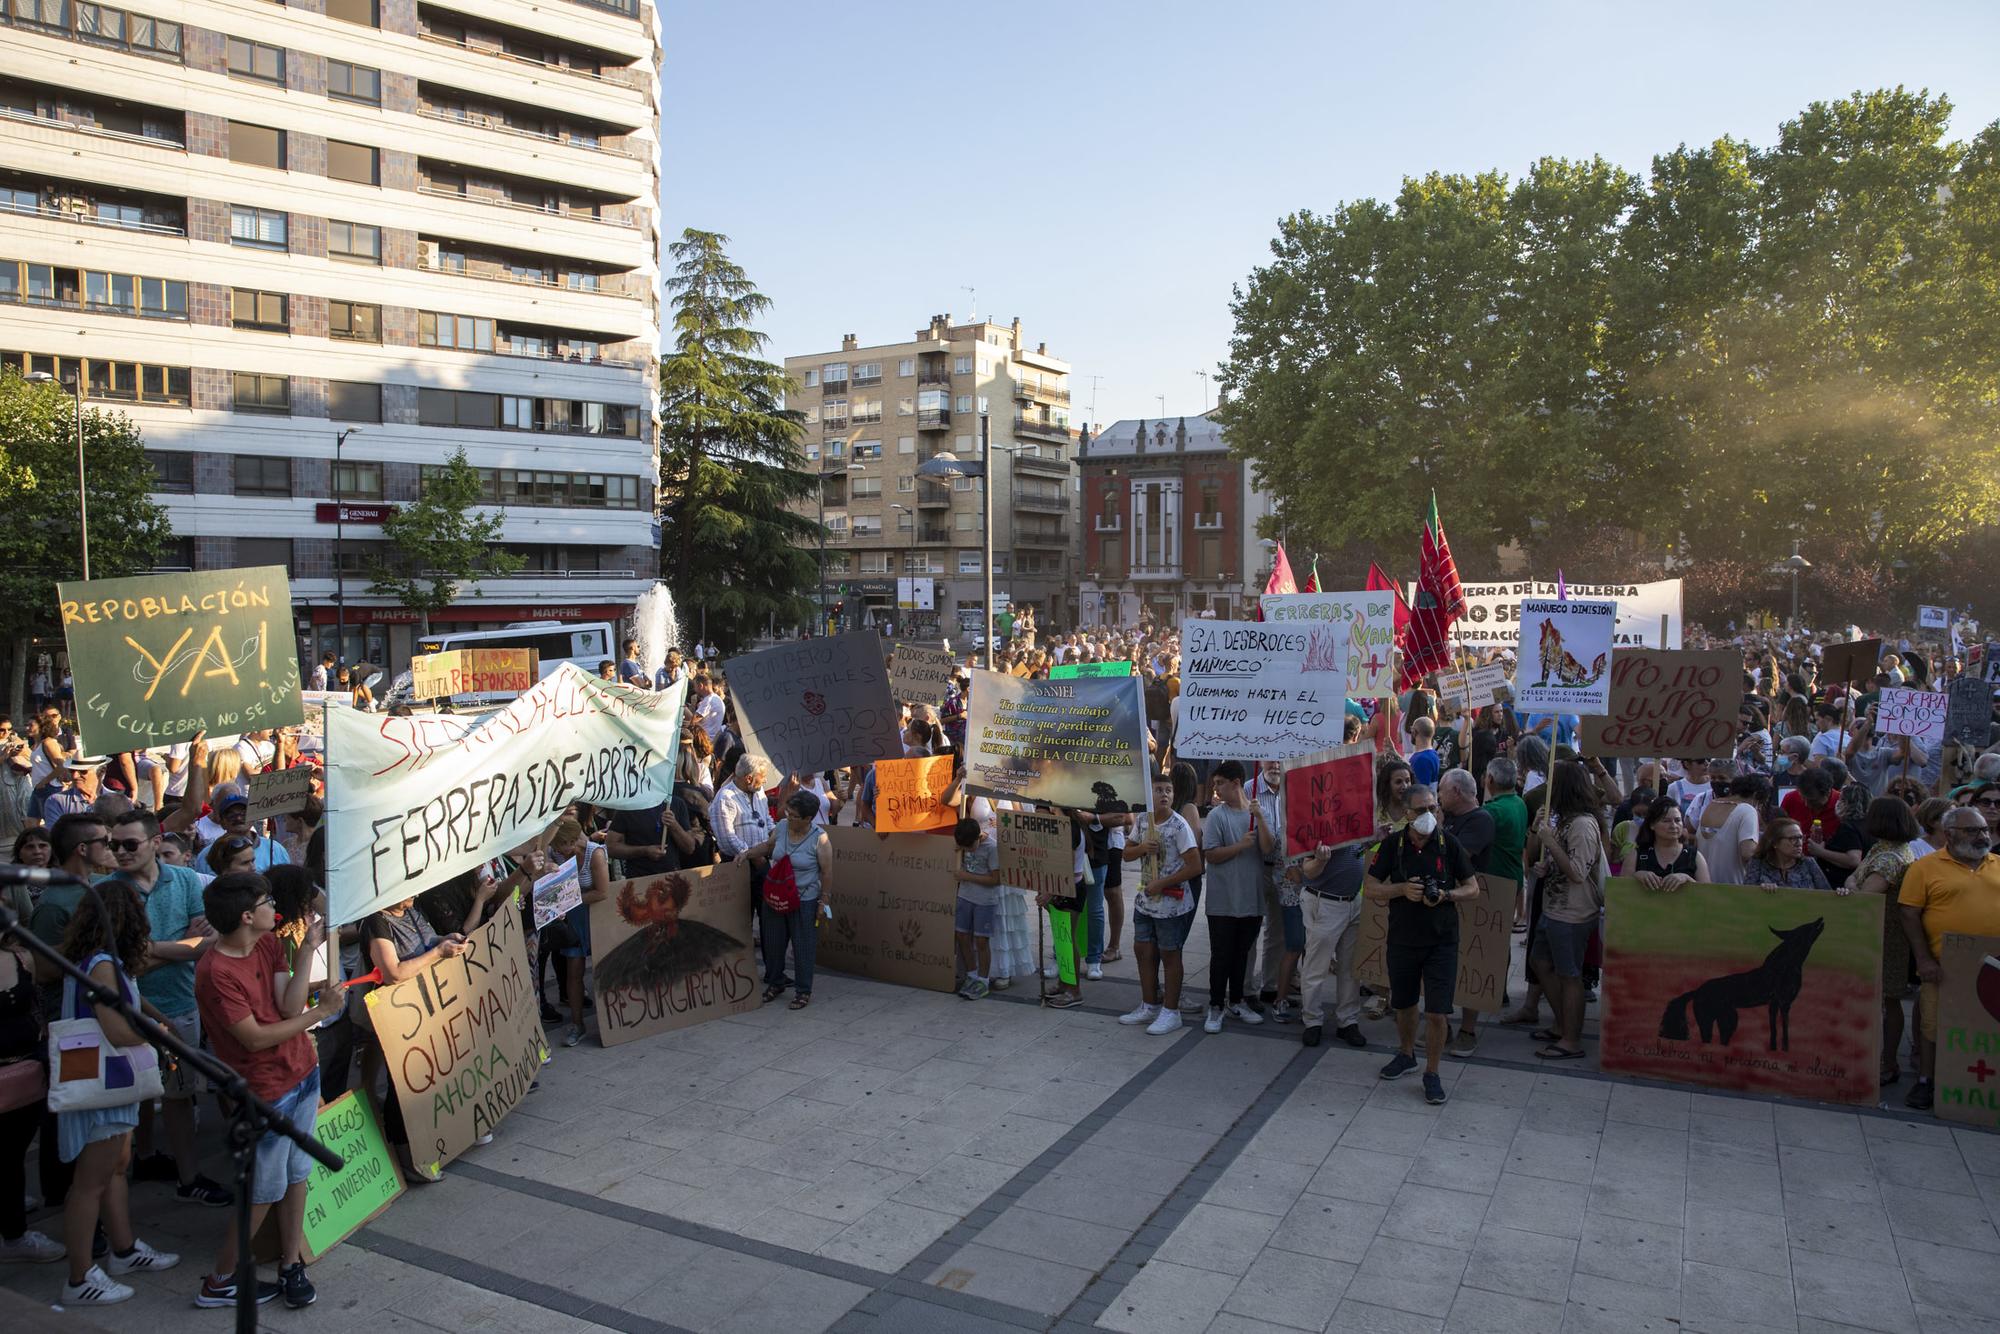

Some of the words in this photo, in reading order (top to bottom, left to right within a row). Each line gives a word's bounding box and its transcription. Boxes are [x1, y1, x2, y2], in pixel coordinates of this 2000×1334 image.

[1463, 586, 1508, 597] IERRA
[1513, 583, 1532, 595] DE
[1537, 584, 1556, 595] LA
[62, 581, 270, 625] REPOBLACIÓN
[532, 608, 582, 617] MAPFRE
[1367, 602, 1391, 617] DE
[1526, 602, 1568, 614] MAÑUECO
[1571, 603, 1612, 616] DIMISIÓN
[372, 610, 420, 619] MAPFR
[1224, 629, 1306, 652] DESBROCES
[124, 621, 267, 701] YA!
[413, 661, 426, 673] EL
[898, 647, 925, 662] TODOS
[925, 652, 955, 667] SOMOS
[894, 665, 907, 678] LA
[909, 668, 939, 683] SIERRA
[87, 693, 111, 719] LA
[117, 714, 208, 736] CULEBRA
[218, 711, 239, 726] NO
[245, 704, 267, 721] SE
[271, 656, 299, 705] CALLA
[417, 677, 449, 699] JUNTA
[902, 688, 937, 706] CULEBRA
[1034, 686, 1076, 698] DANIEL
[1248, 688, 1287, 701] HASTA
[1297, 689, 1318, 703] EL
[1880, 690, 1895, 704] LA
[1000, 699, 1014, 710] Tu
[1061, 707, 1067, 716] y
[1069, 705, 1110, 719] trabajo
[1263, 710, 1325, 726] HUECO
[1878, 703, 1947, 724] SOMOS
[747, 707, 892, 742] TRABAJOS
[993, 713, 1035, 727] hicieron
[1037, 721, 1056, 731] que
[1056, 721, 1113, 733] perdieras
[983, 727, 993, 739] la
[995, 729, 1017, 741] vida
[1019, 733, 1031, 742] en
[1033, 733, 1042, 743] el
[1044, 735, 1095, 748] incendio
[1097, 738, 1111, 749] de
[1116, 739, 1129, 749] la
[980, 742, 1019, 756] SIERRA
[1023, 747, 1040, 758] DE
[1043, 750, 1060, 760] LA
[1065, 751, 1132, 766] CULEBRA
[877, 762, 916, 778] MALA
[1311, 771, 1333, 798] NO
[1311, 793, 1342, 819] NOS
[1015, 815, 1059, 835] CABRAS
[887, 850, 953, 873] AMBIENTAL
[391, 906, 515, 1040] SIERRA
[603, 958, 754, 1029] RESURGIREMOS
[403, 957, 524, 1093] QUEMADA
[1644, 1039, 1690, 1061] culebra
[1698, 1051, 1713, 1064] ni
[433, 1043, 510, 1128] AHORA
[317, 1104, 365, 1147] FUEGOS
[307, 1203, 327, 1230] EN
[331, 1157, 381, 1209] INVIERNO
